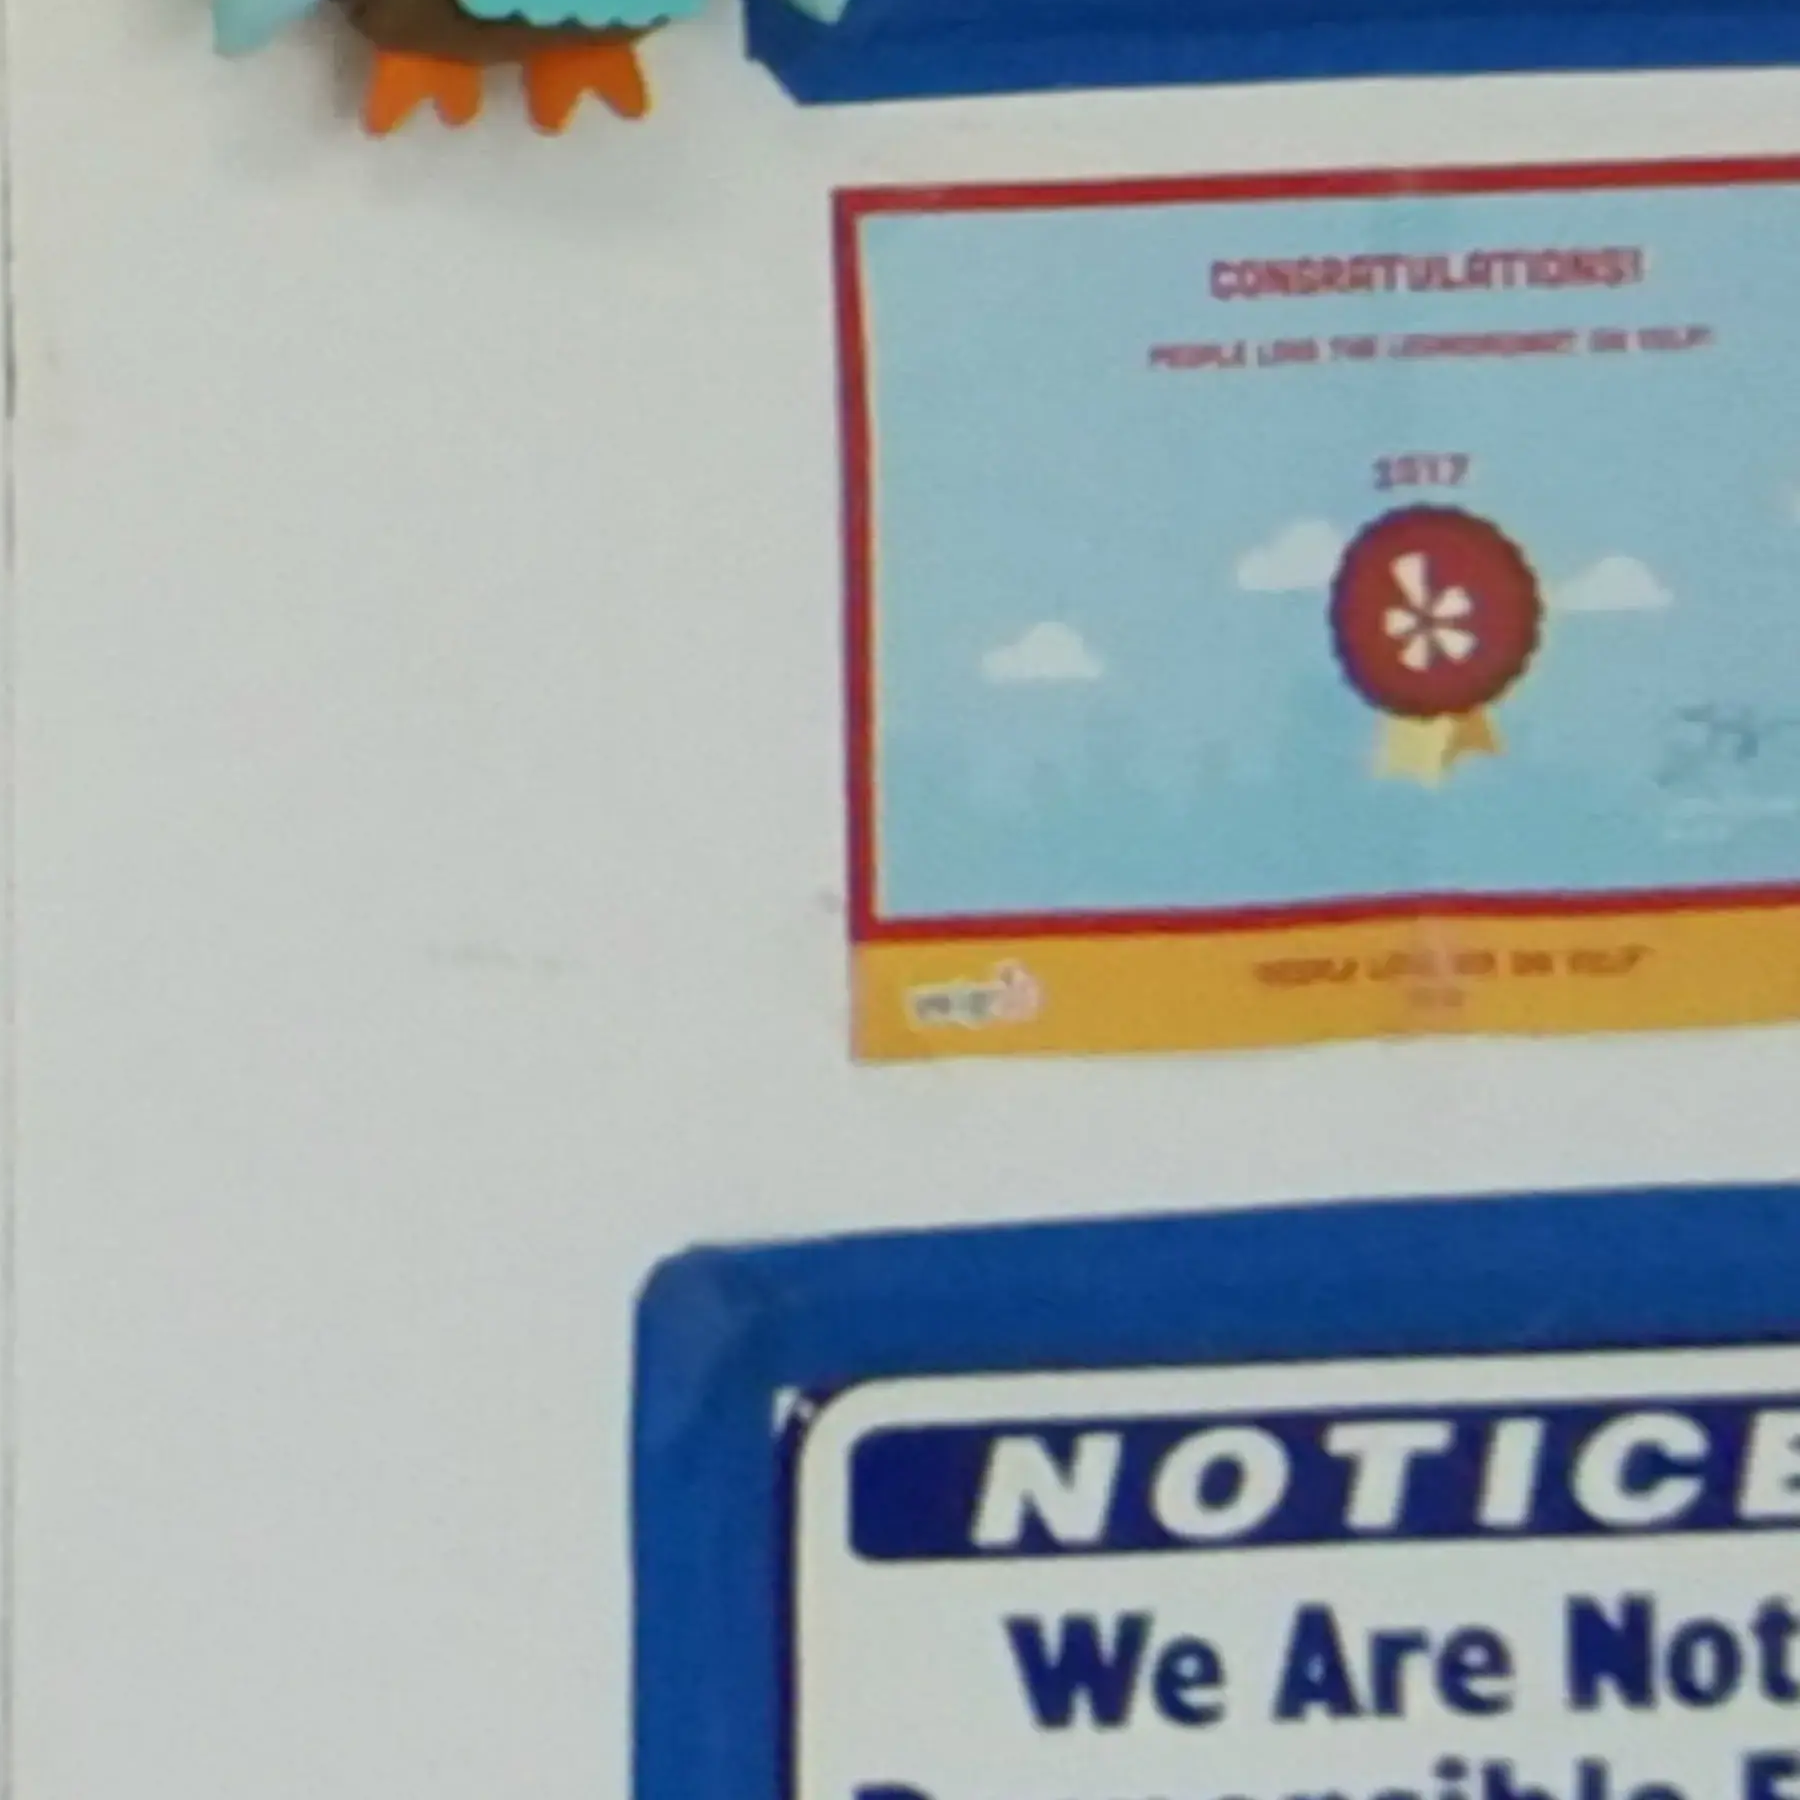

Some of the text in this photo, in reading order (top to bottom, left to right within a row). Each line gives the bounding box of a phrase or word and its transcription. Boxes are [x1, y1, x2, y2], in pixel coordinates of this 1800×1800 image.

[1003, 1591, 1800, 1731] We Are Not
